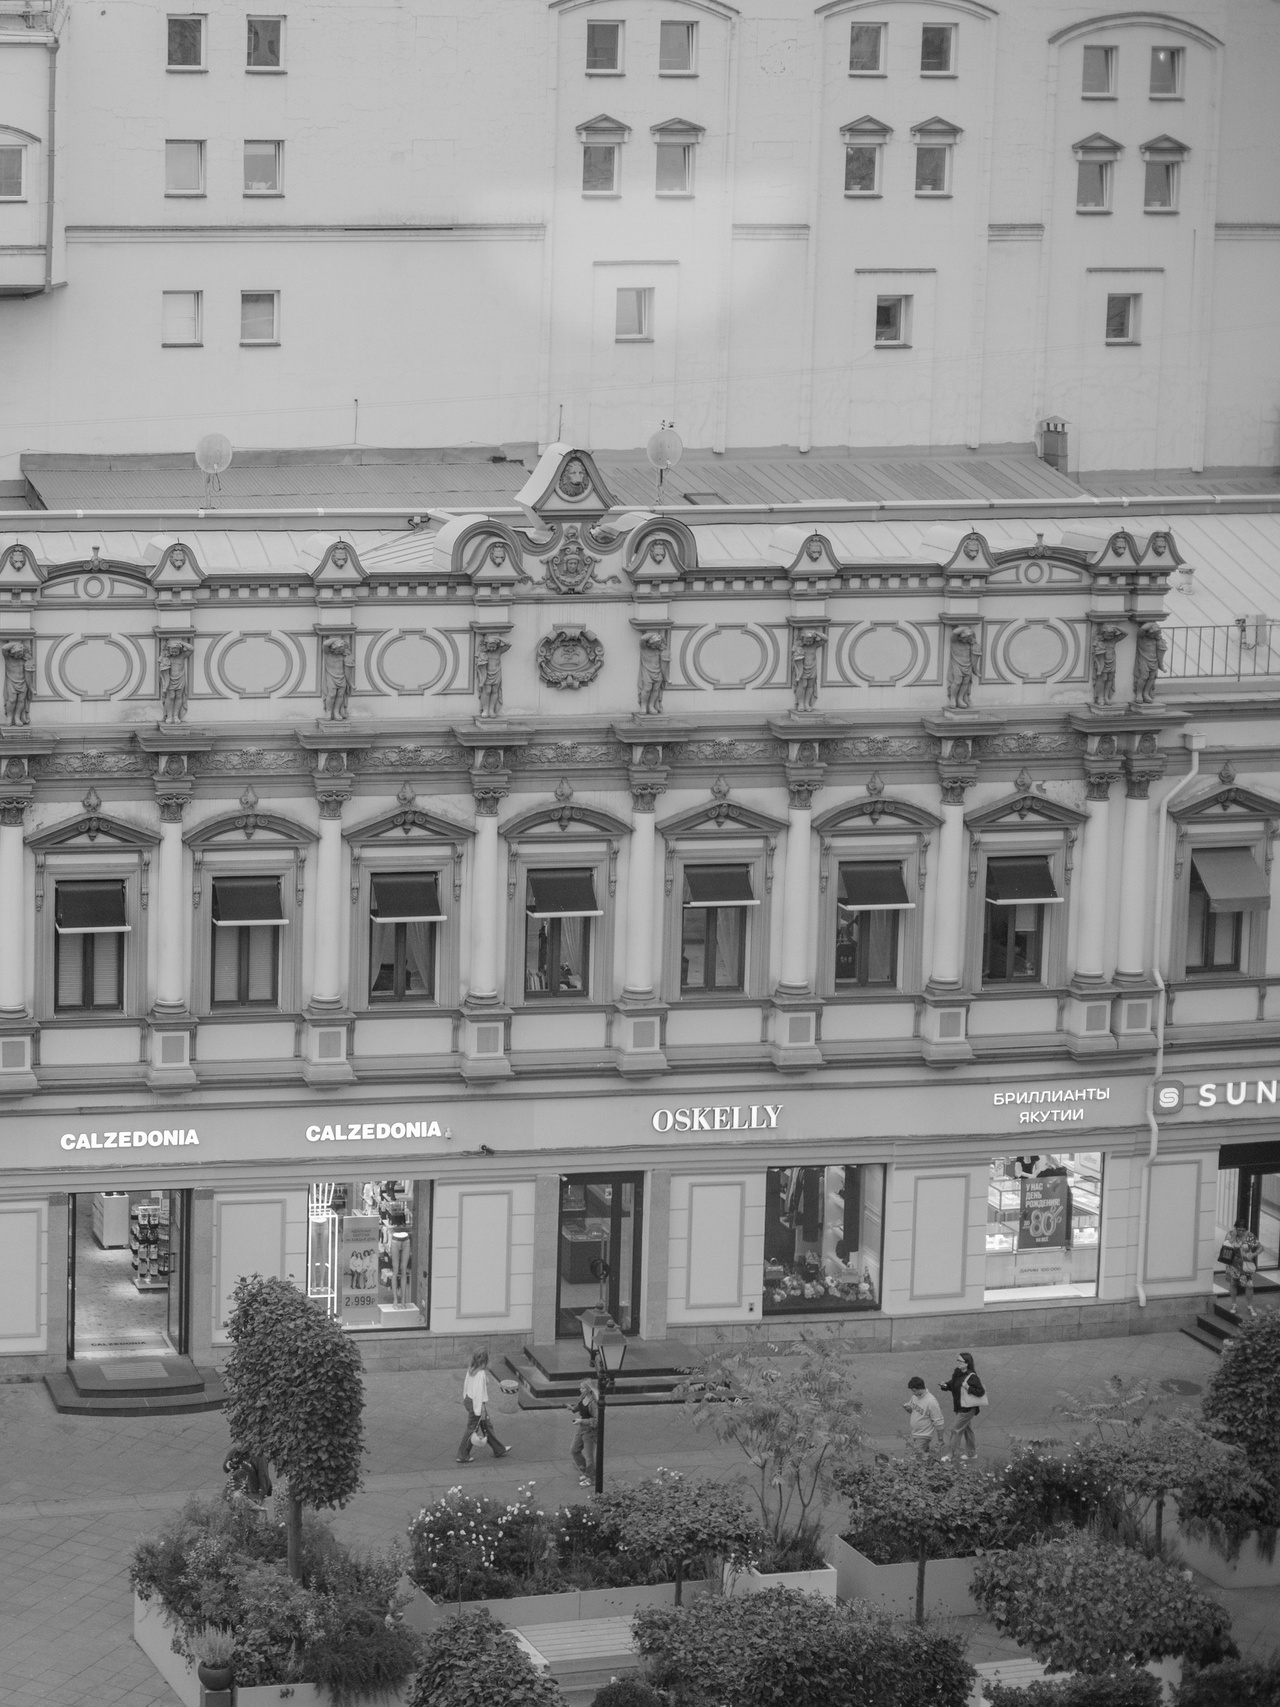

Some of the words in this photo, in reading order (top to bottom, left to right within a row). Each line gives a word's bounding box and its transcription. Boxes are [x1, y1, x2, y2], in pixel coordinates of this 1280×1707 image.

[993, 1087, 1110, 1105] БРИЛЛИАНТЫ
[1198, 1080, 1278, 1107] SUN
[652, 1104, 784, 1133] OSKELLY
[1019, 1108, 1084, 1124] ЯКУТИИ
[59, 1128, 200, 1150] CALZEDONIA
[305, 1120, 442, 1142] CALZEDONIA
[1025, 1183, 1031, 1191] У
[1031, 1182, 1043, 1191] НАС
[1025, 1191, 1042, 1200] ДЕНЬ
[1025, 1198, 1061, 1208] РОЖДЕНИЯ!
